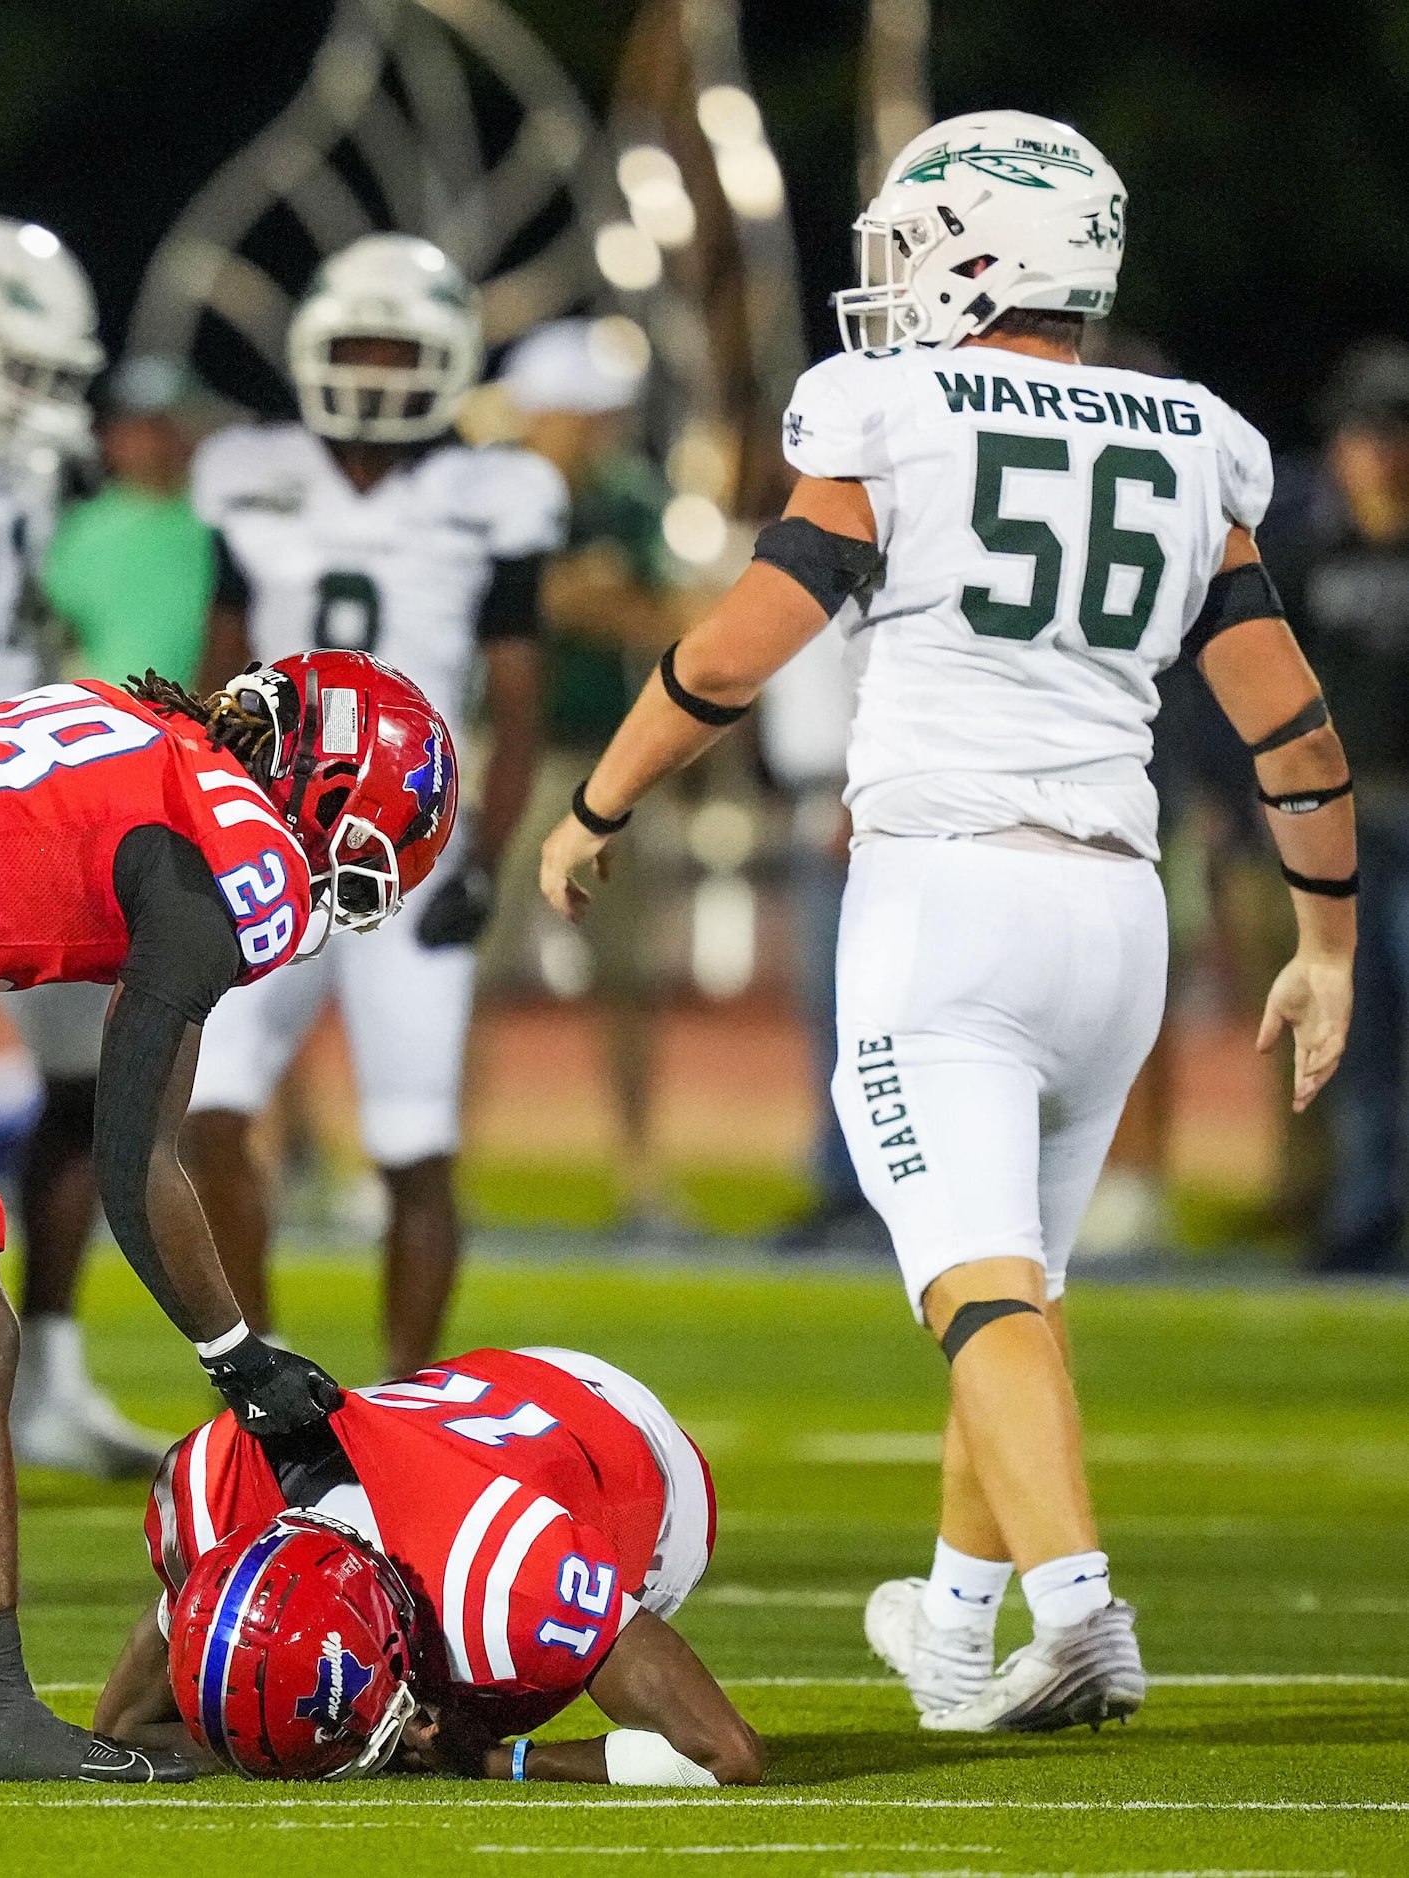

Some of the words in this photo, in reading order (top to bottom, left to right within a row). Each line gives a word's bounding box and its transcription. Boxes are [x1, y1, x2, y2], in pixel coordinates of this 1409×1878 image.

[1015, 138, 1080, 160] INDIANS
[934, 370, 1202, 437] WARSING
[959, 430, 1177, 650] 56
[214, 849, 295, 966] 28
[858, 1035, 927, 1184] HACHIE
[535, 1551, 617, 1659] 12
